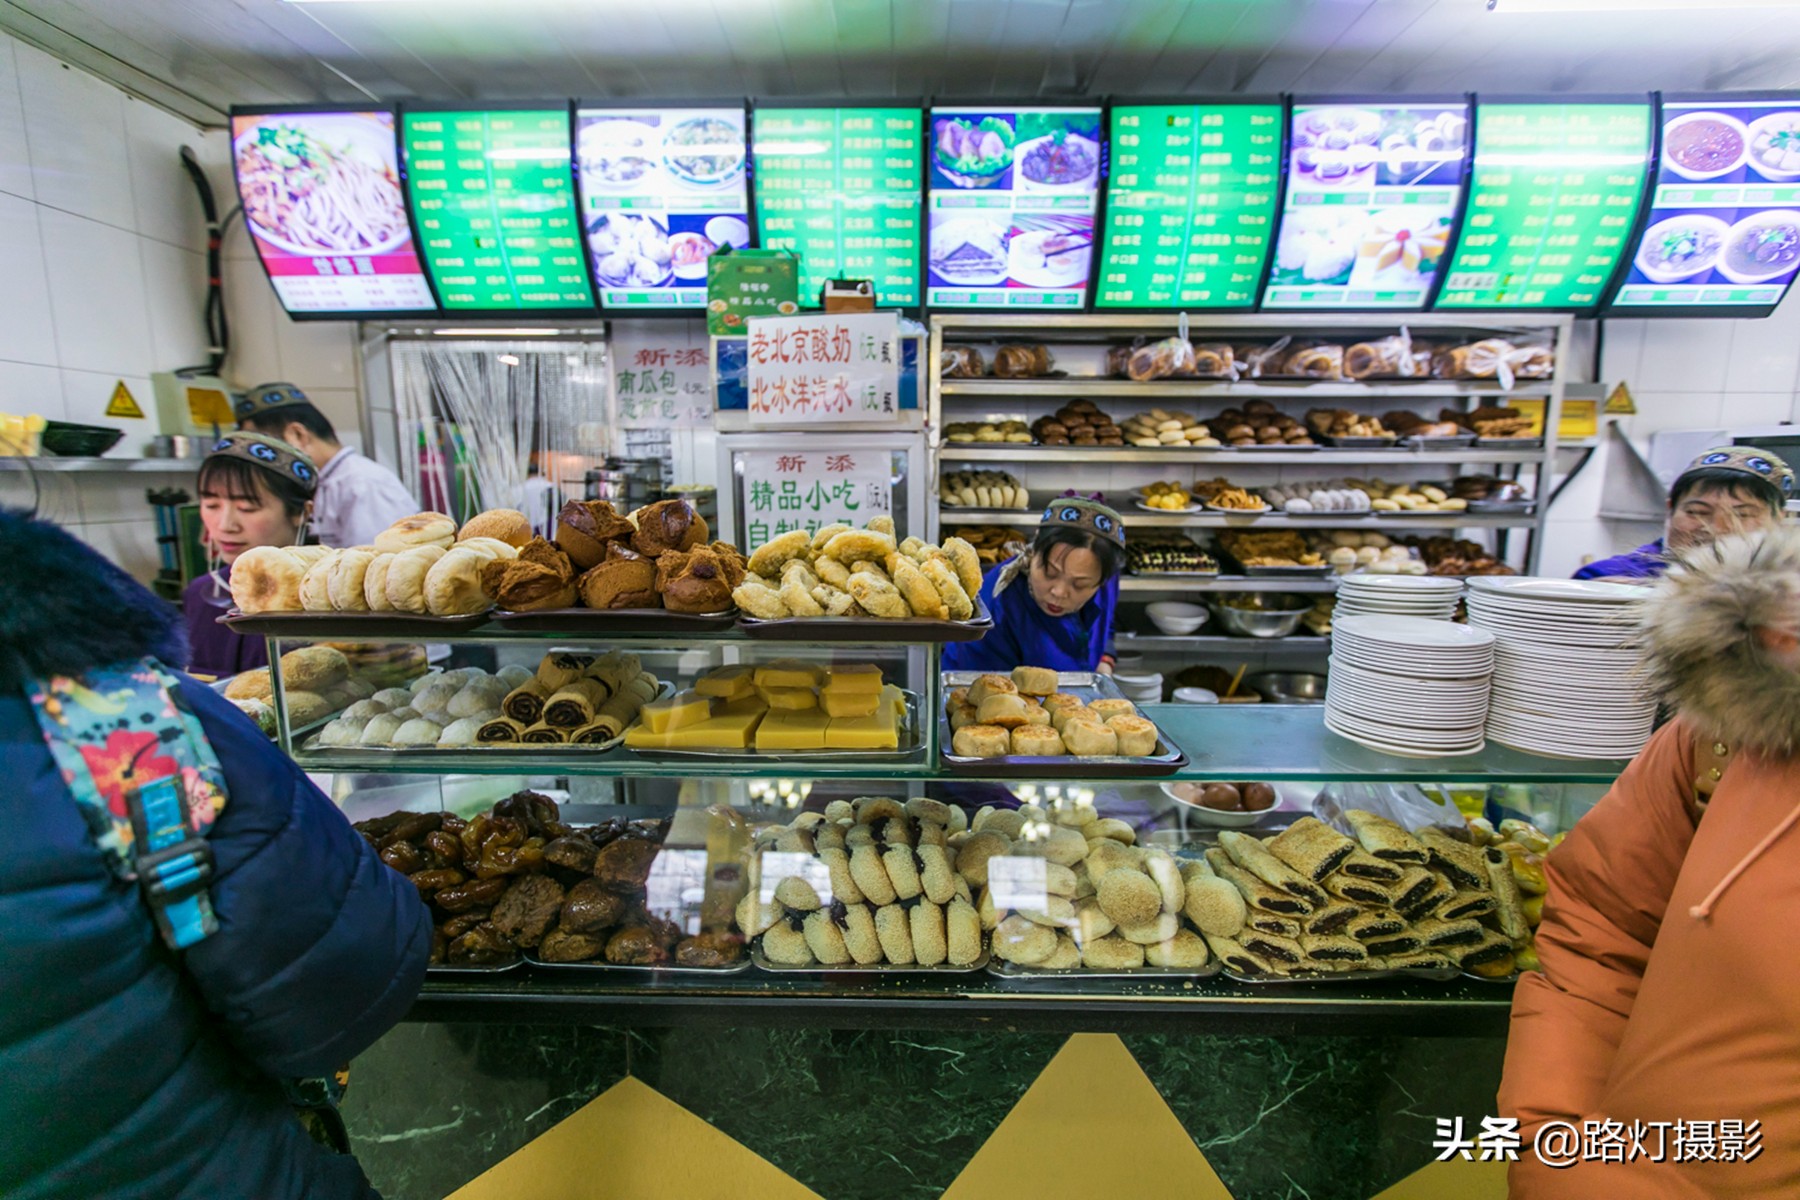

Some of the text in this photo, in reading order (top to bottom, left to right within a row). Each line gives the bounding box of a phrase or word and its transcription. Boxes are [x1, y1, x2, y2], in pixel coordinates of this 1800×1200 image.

[634, 348, 710, 367] 新添
[751, 324, 852, 364] 老北京酸奶
[616, 369, 678, 395] 南瓜包
[751, 374, 853, 414] 北冰洋汽水
[776, 454, 856, 473] 新添
[750, 479, 860, 512] 精品小吃
